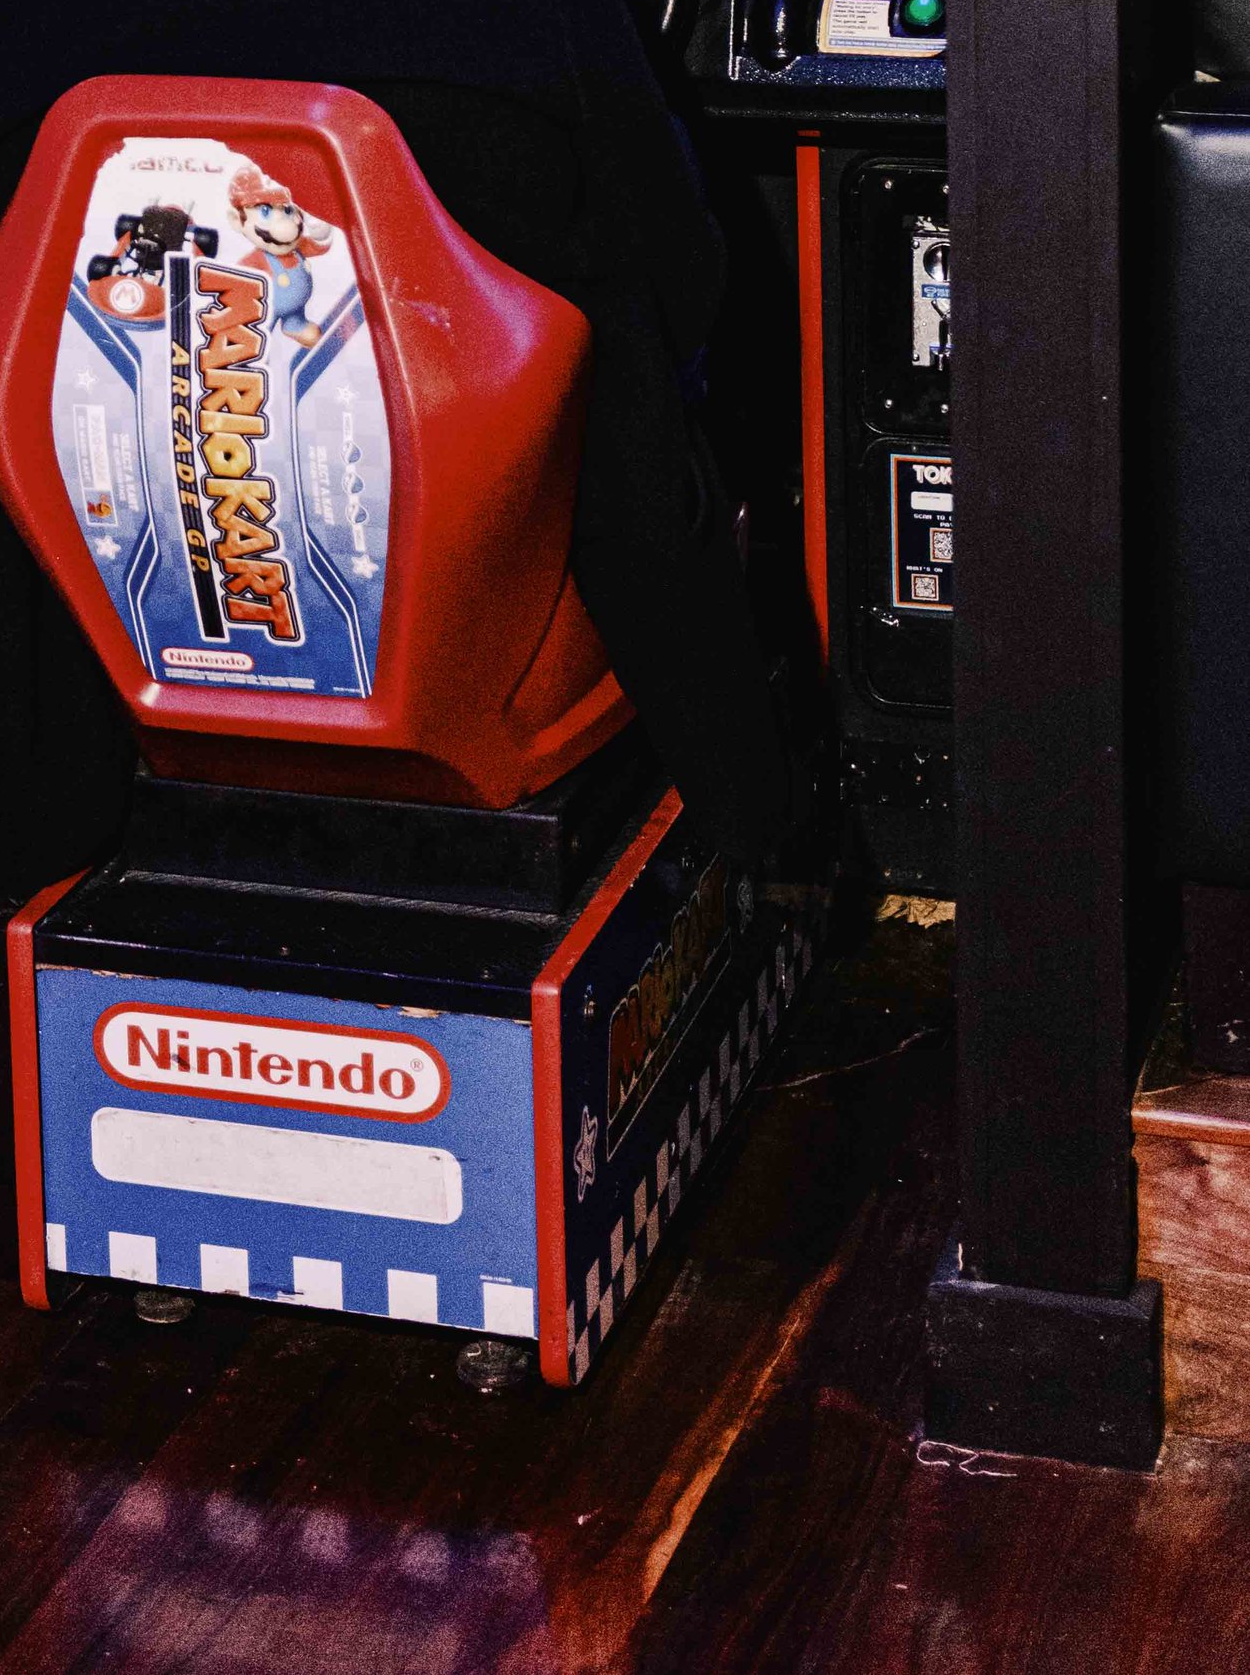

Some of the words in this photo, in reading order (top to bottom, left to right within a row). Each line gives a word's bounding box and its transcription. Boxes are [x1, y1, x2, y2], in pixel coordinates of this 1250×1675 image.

[170, 340, 201, 508] ARCADE
[912, 464, 952, 485] TOK
[168, 651, 246, 667] Nintendo
[126, 1023, 418, 1101] Nintendo
